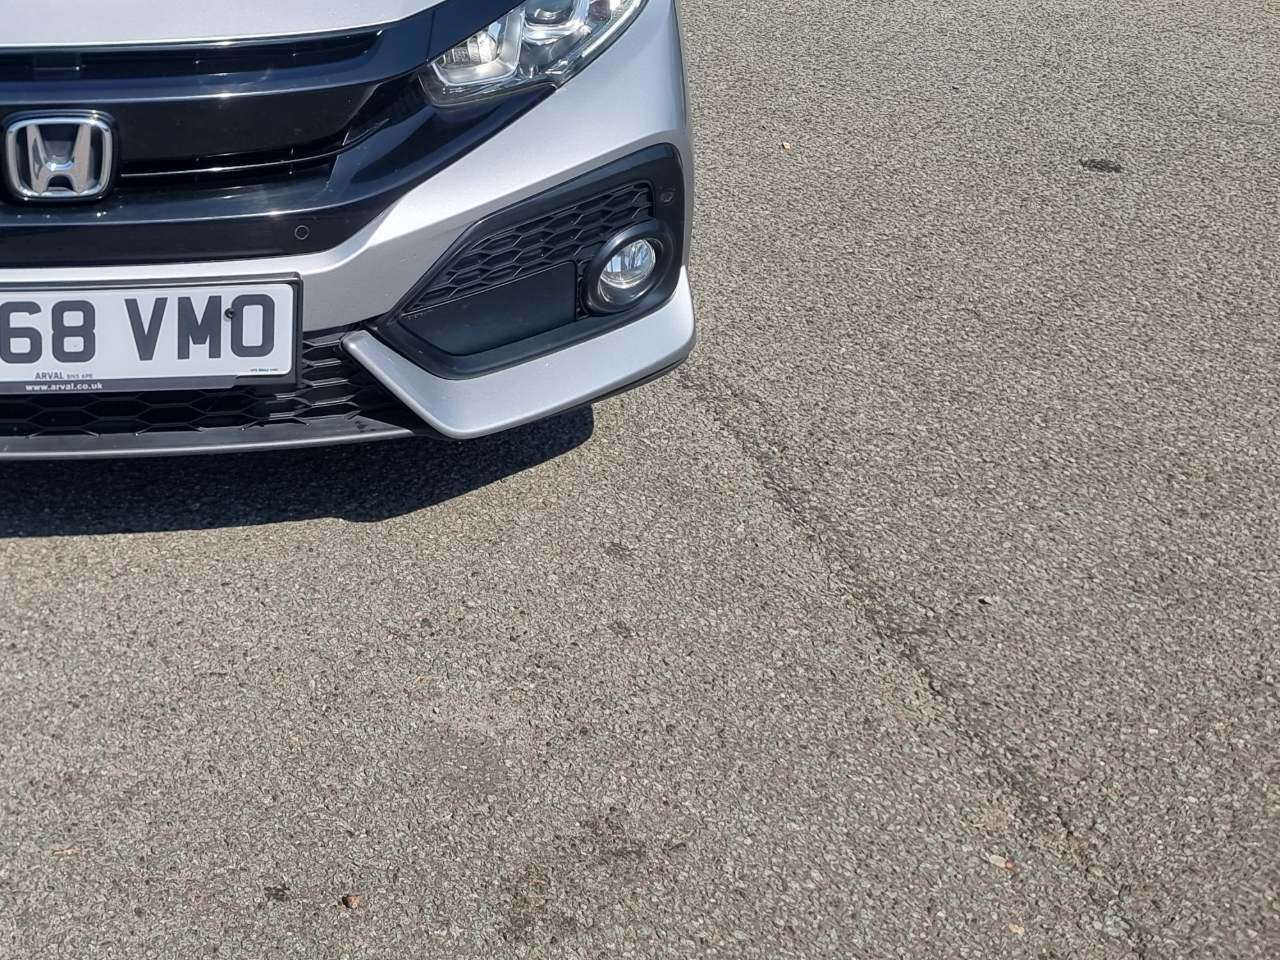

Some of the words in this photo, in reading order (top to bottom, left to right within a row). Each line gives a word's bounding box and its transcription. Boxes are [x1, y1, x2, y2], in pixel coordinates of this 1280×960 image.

[124, 294, 275, 361] VMO
[35, 372, 64, 380] ARVAL
[25, 382, 103, 391] www.arval.co.uk
